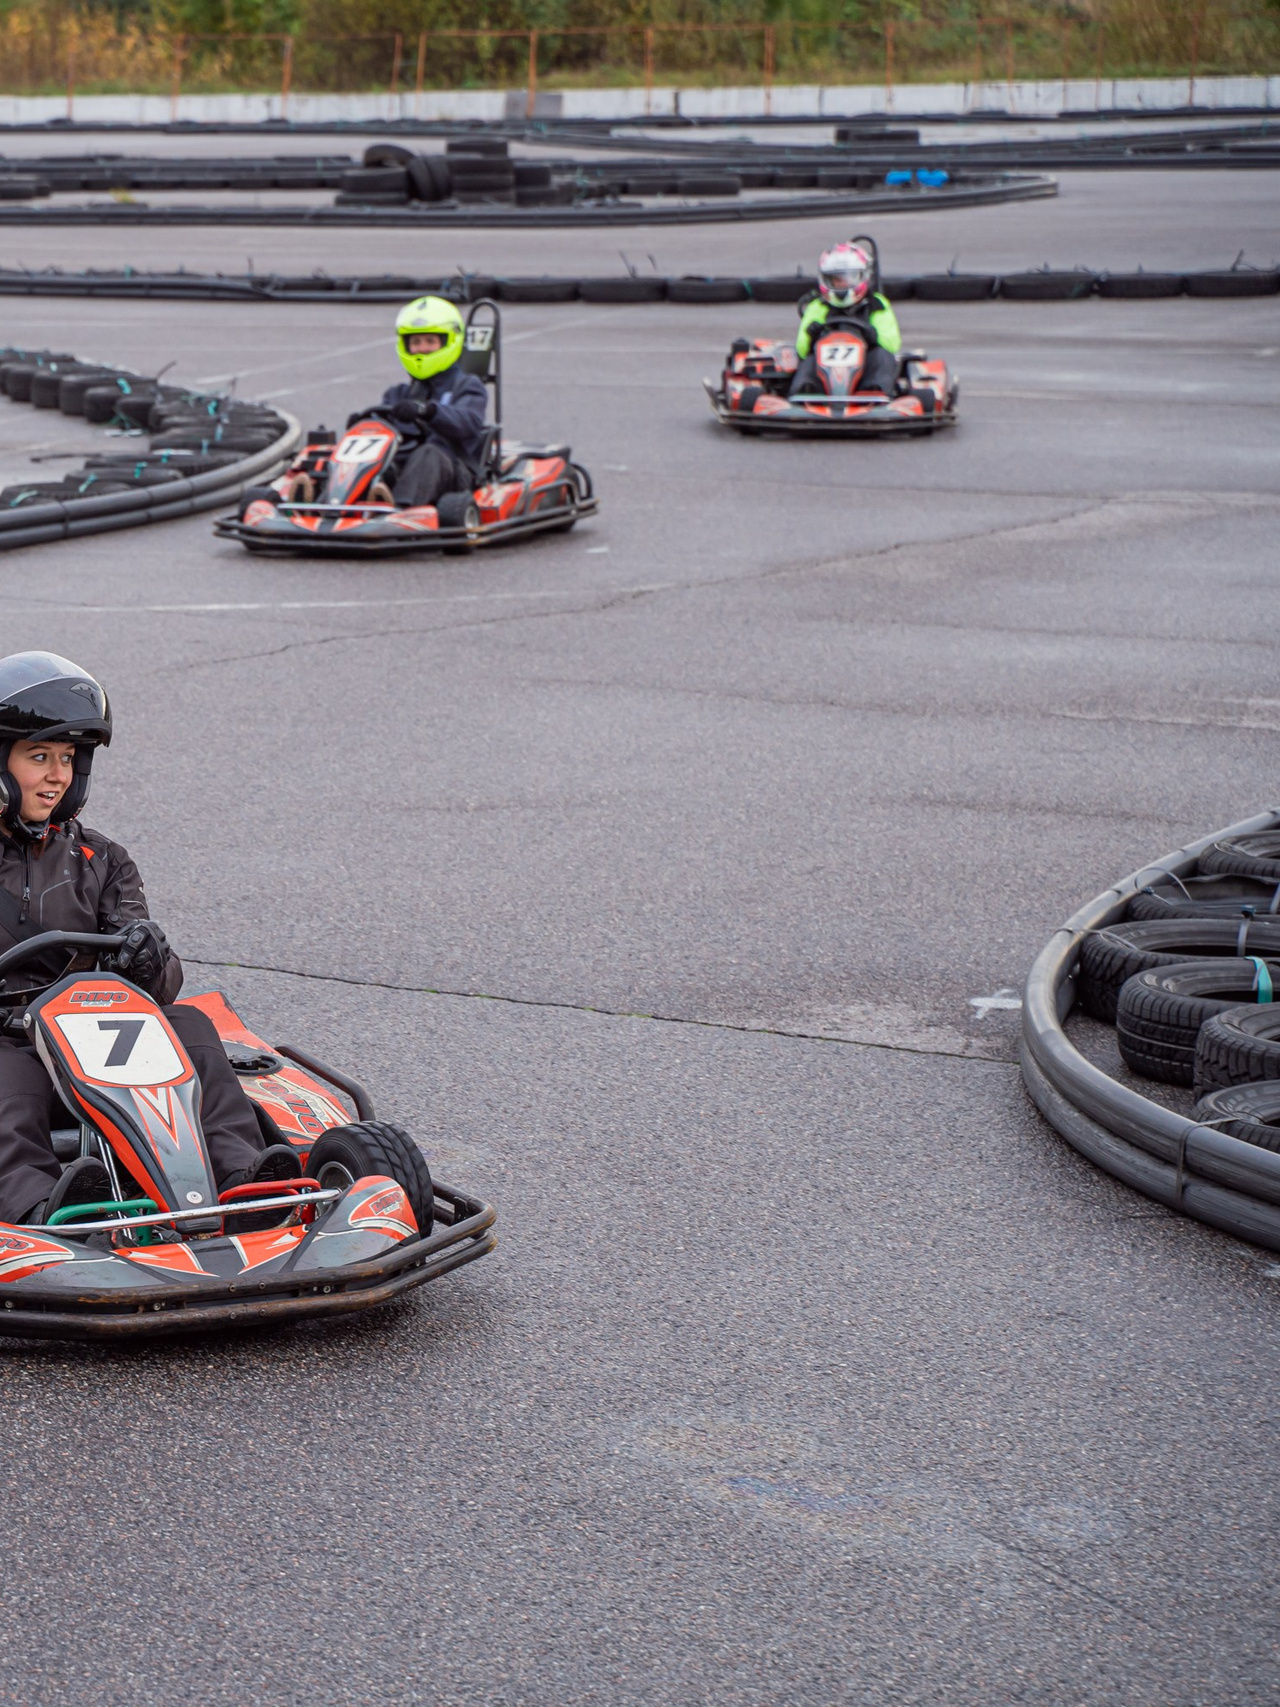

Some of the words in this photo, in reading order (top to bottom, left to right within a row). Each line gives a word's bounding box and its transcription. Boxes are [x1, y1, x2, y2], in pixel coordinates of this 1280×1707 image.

[470, 330, 489, 345] 17
[343, 438, 382, 456] 17
[70, 991, 129, 1003] DINO
[97, 1020, 146, 1067] 7
